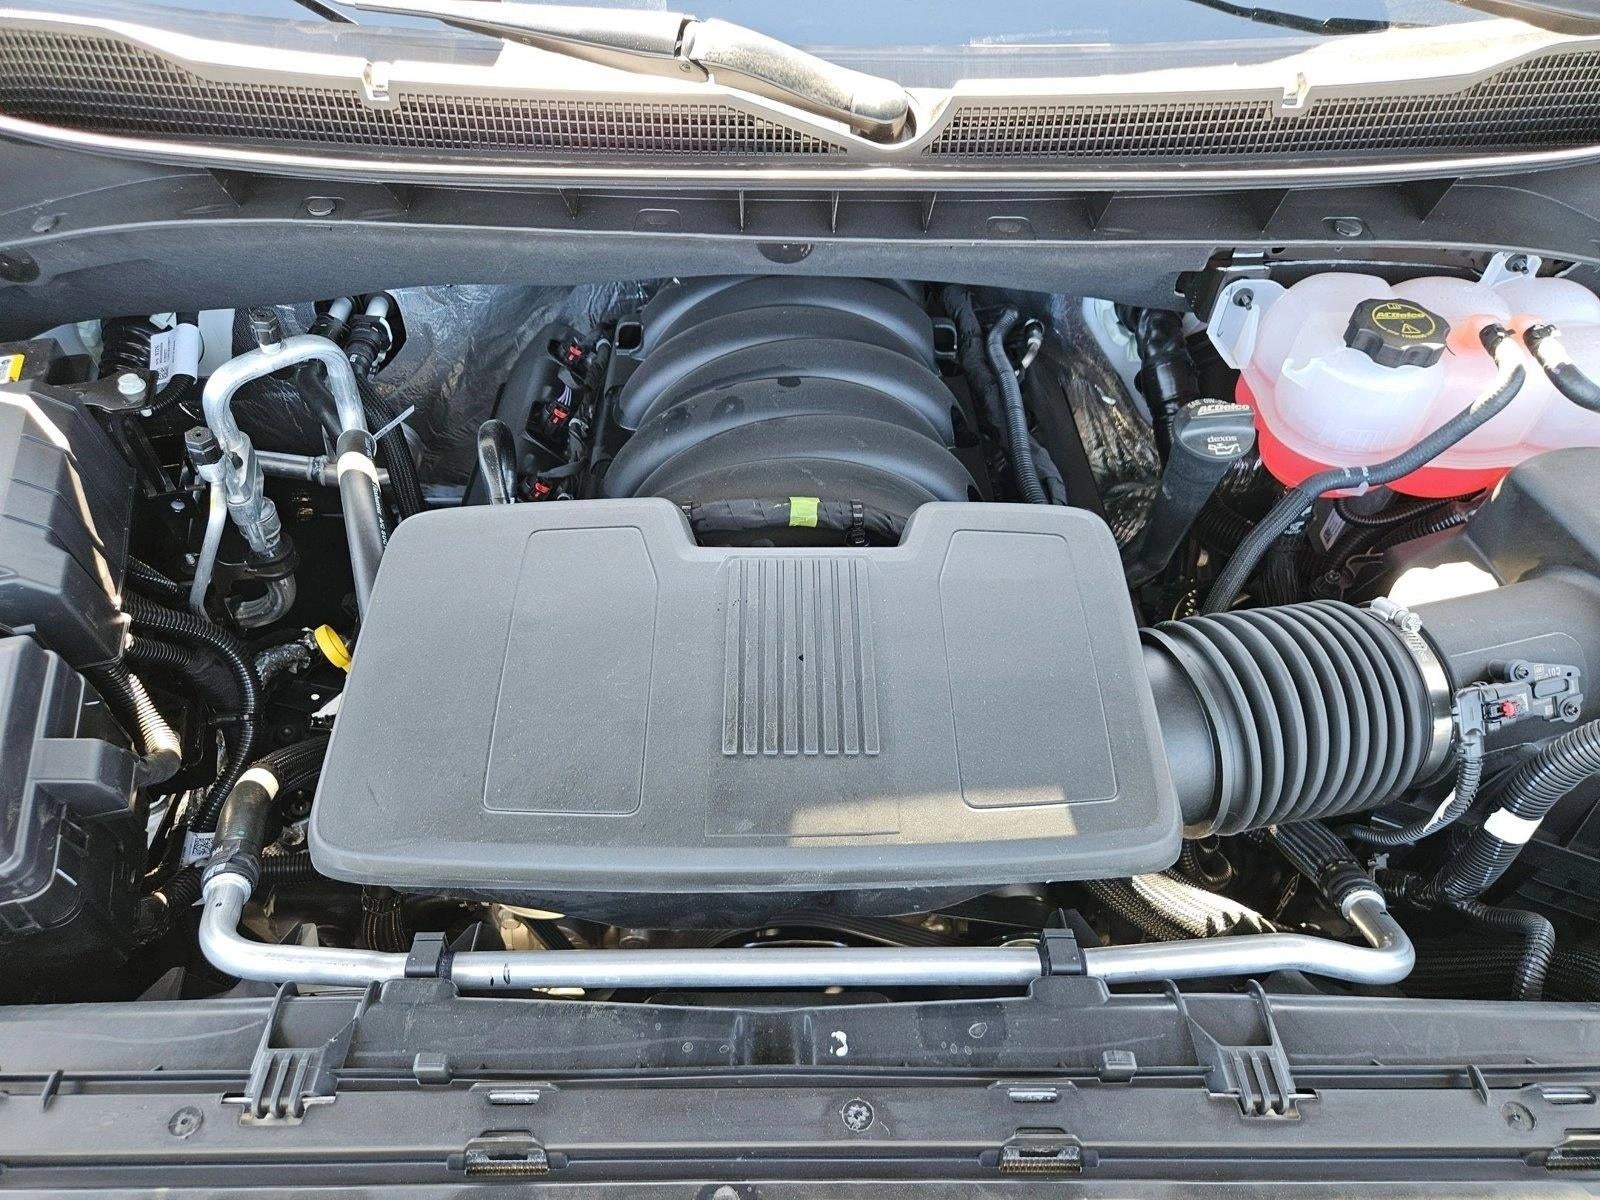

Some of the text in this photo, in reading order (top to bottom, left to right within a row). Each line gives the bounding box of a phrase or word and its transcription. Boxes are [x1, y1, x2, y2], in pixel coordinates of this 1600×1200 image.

[1375, 311, 1426, 320] ACDelco
[1197, 403, 1250, 416] ACDelco
[1207, 435, 1238, 443] dexos
